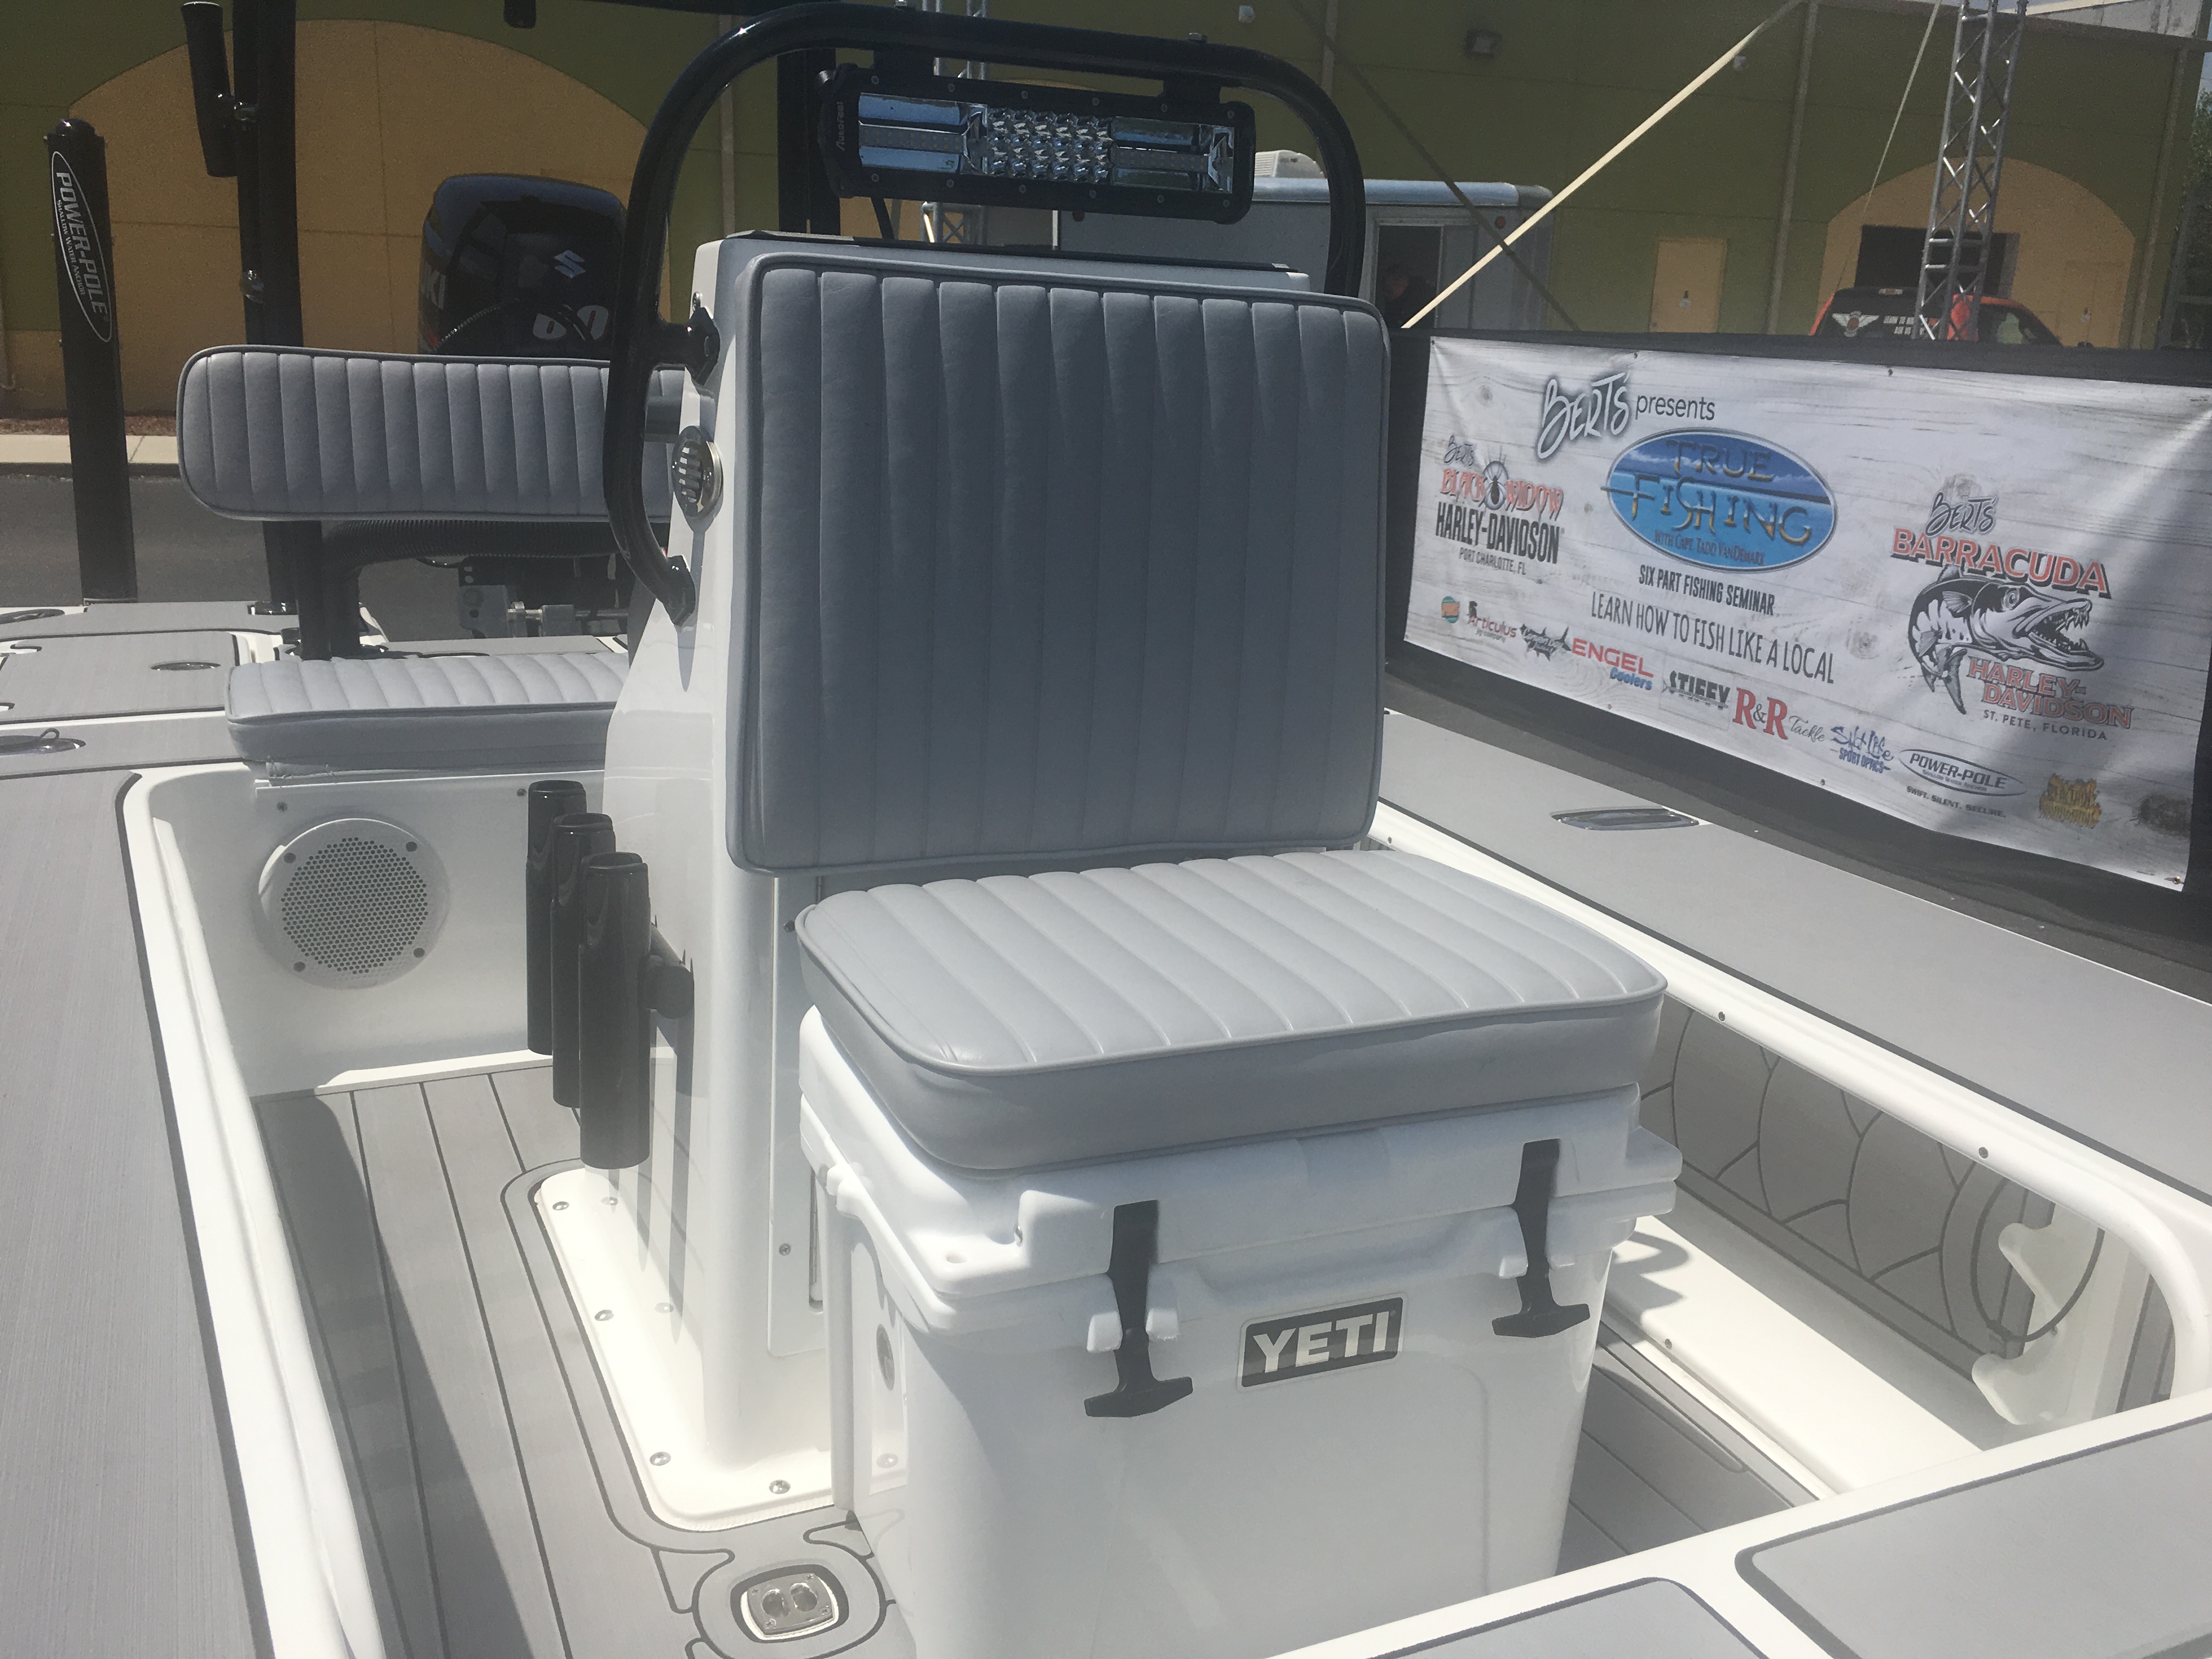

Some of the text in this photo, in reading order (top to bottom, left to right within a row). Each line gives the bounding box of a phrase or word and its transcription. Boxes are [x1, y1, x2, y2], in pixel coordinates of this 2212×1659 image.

[57, 172, 108, 314] POWER-POLE
[1635, 393, 1716, 421] presents
[1666, 441, 1775, 483] TRUE
[1440, 469, 1564, 520] BLACK WIDOW
[1628, 473, 1812, 548] FISHING
[1436, 501, 1560, 565] HARLEY-DAVIDSON
[1459, 547, 1476, 563] PORT
[1517, 561, 1526, 575] FL
[1891, 527, 2111, 599] BARRACUDA
[1639, 565, 1775, 616] SIX PART FISHING SEMINAR
[1467, 616, 1518, 638] Articulus
[1592, 591, 1834, 684] LEARN HOW TO FISH LIKE A LOCAL
[1571, 637, 1654, 678] ENGEL
[1609, 666, 1653, 691] Coolers
[1967, 656, 2086, 699] HARLEY-
[1732, 687, 1826, 743] R&R Tackle
[1981, 681, 2135, 729] DAVIDSON
[2002, 714, 2036, 732] PETE,
[2042, 723, 2108, 741] FLORIDA
[1838, 747, 1886, 774] SPORT OPTICS
[1909, 753, 2008, 789] POWER-POLE
[1906, 785, 1929, 800] SWIFT.
[1931, 794, 1962, 809] SILENT.
[1253, 1311, 1390, 1373] YETI
